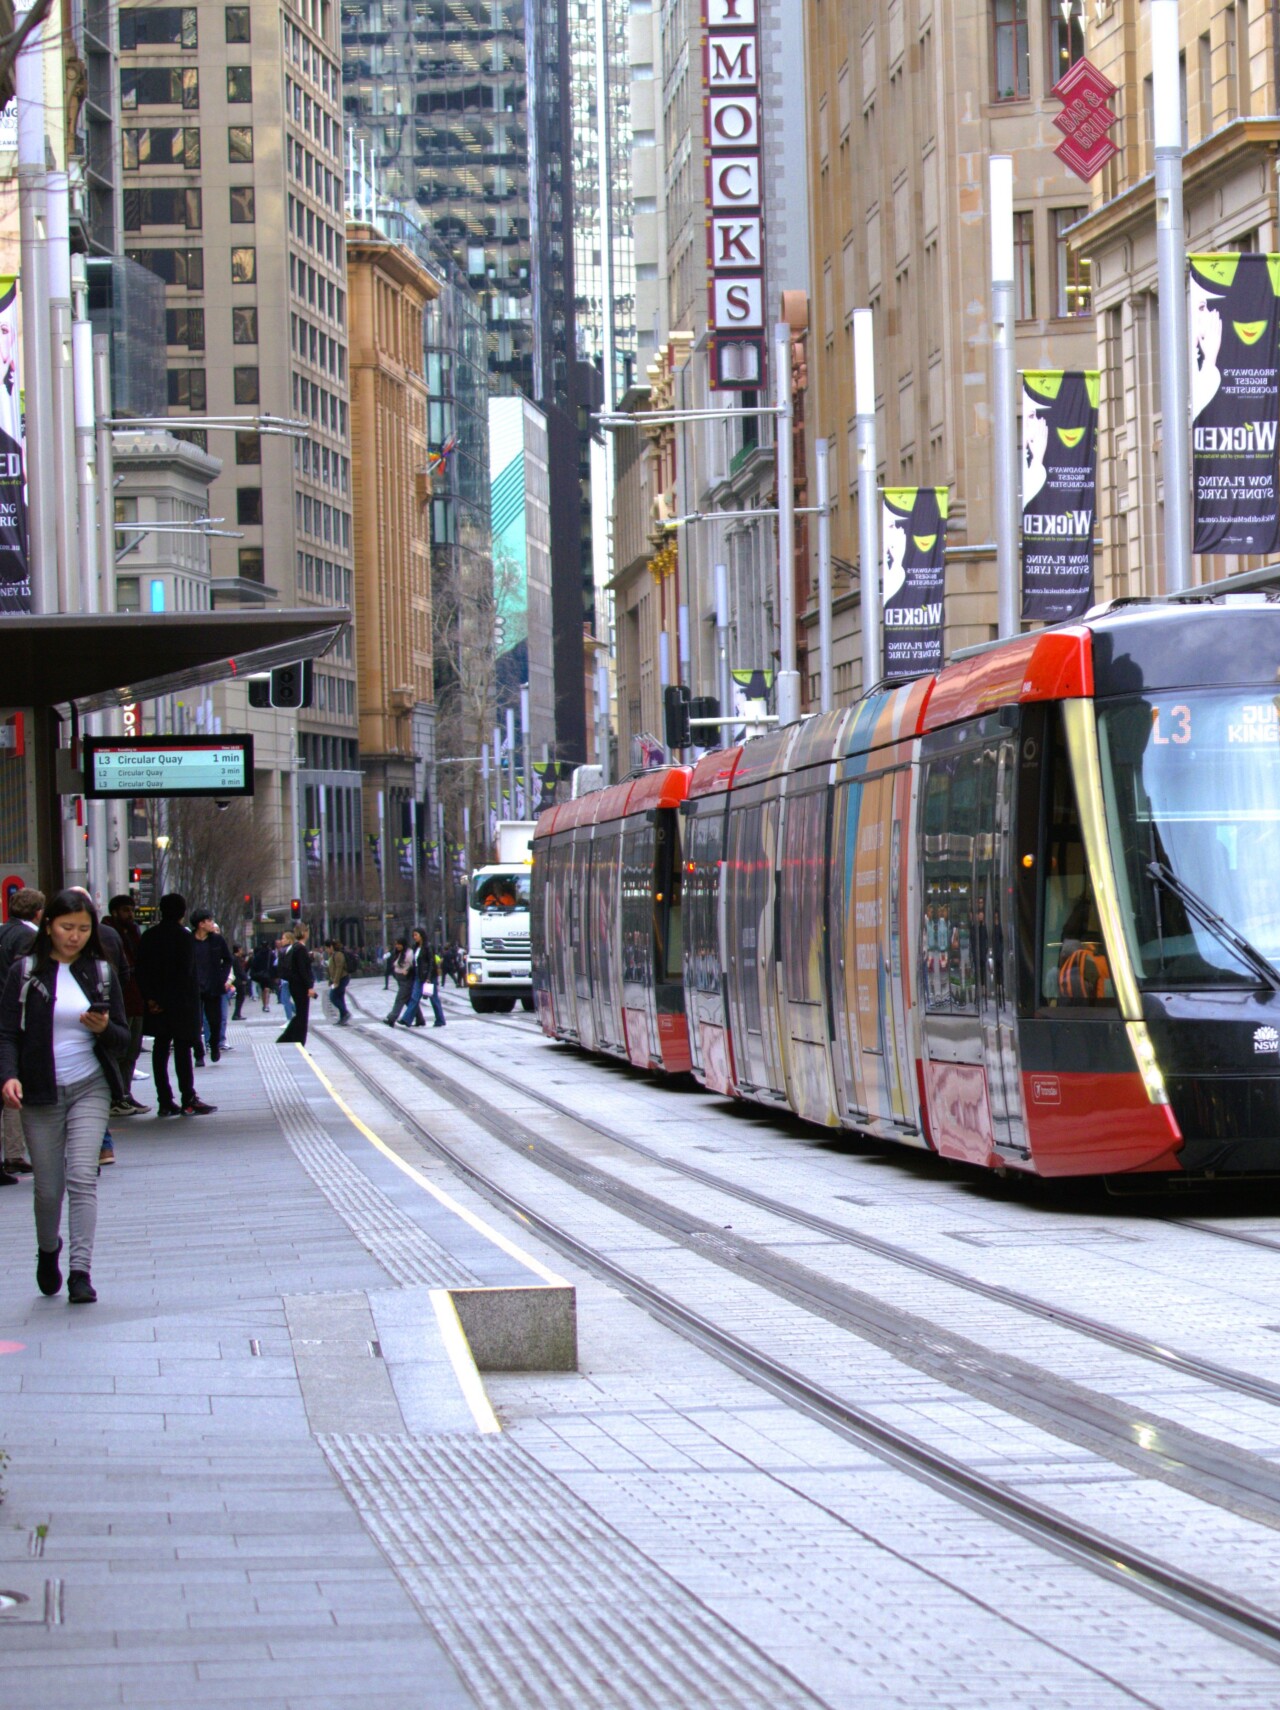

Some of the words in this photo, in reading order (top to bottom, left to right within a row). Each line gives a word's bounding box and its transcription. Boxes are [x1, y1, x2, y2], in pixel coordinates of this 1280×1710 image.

[1057, 98, 1091, 133] BAR
[1073, 107, 1117, 149] GRILL
[1151, 705, 1192, 745] L3
[98, 756, 111, 765] L3
[118, 755, 155, 765] Circular
[158, 755, 183, 765] Quay
[213, 754, 219, 763] 1
[222, 753, 240, 762] min
[146, 769, 163, 777] Quay
[118, 780, 144, 788] Circular
[146, 780, 163, 788] Quay
[1254, 1041, 1279, 1050] NSW
